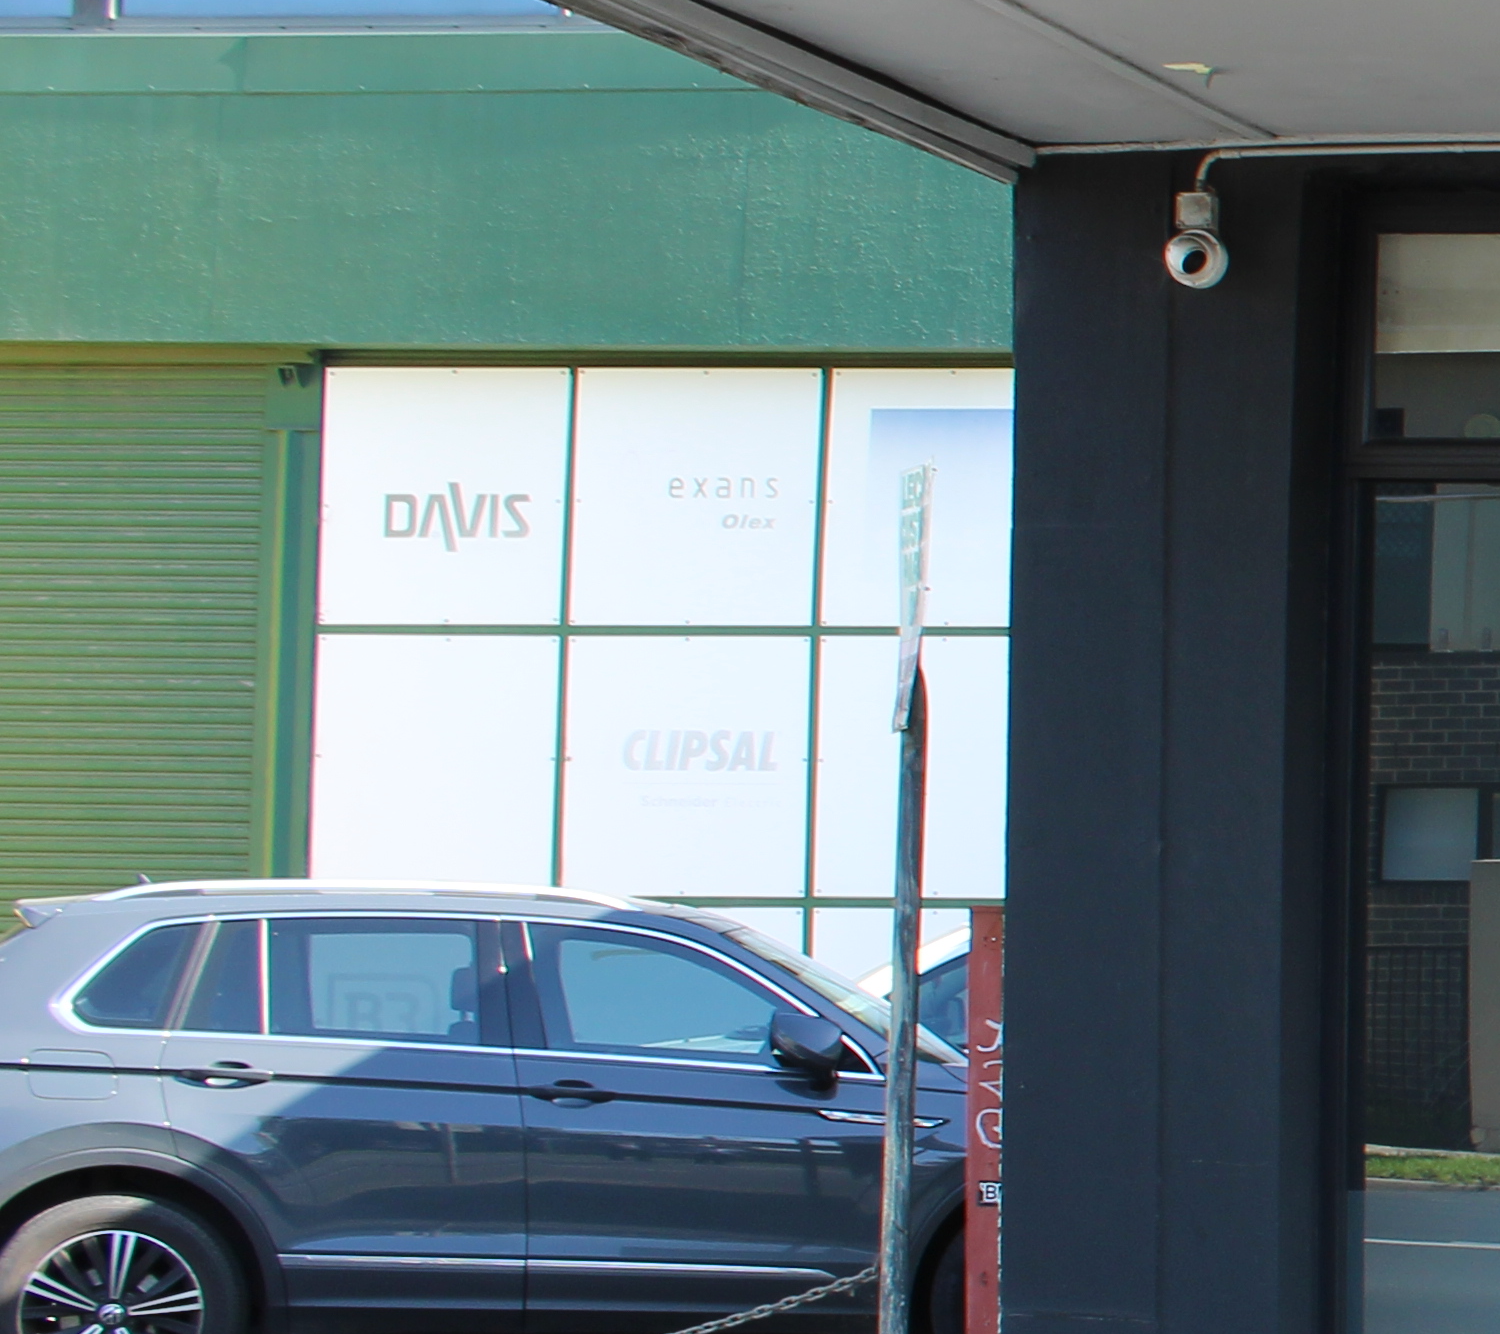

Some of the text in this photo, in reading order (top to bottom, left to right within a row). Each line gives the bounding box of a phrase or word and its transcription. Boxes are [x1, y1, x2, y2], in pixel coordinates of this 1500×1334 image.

[384, 482, 530, 552] DAVIS
[720, 513, 776, 530] Olex
[622, 729, 779, 772] CLIPSAL
